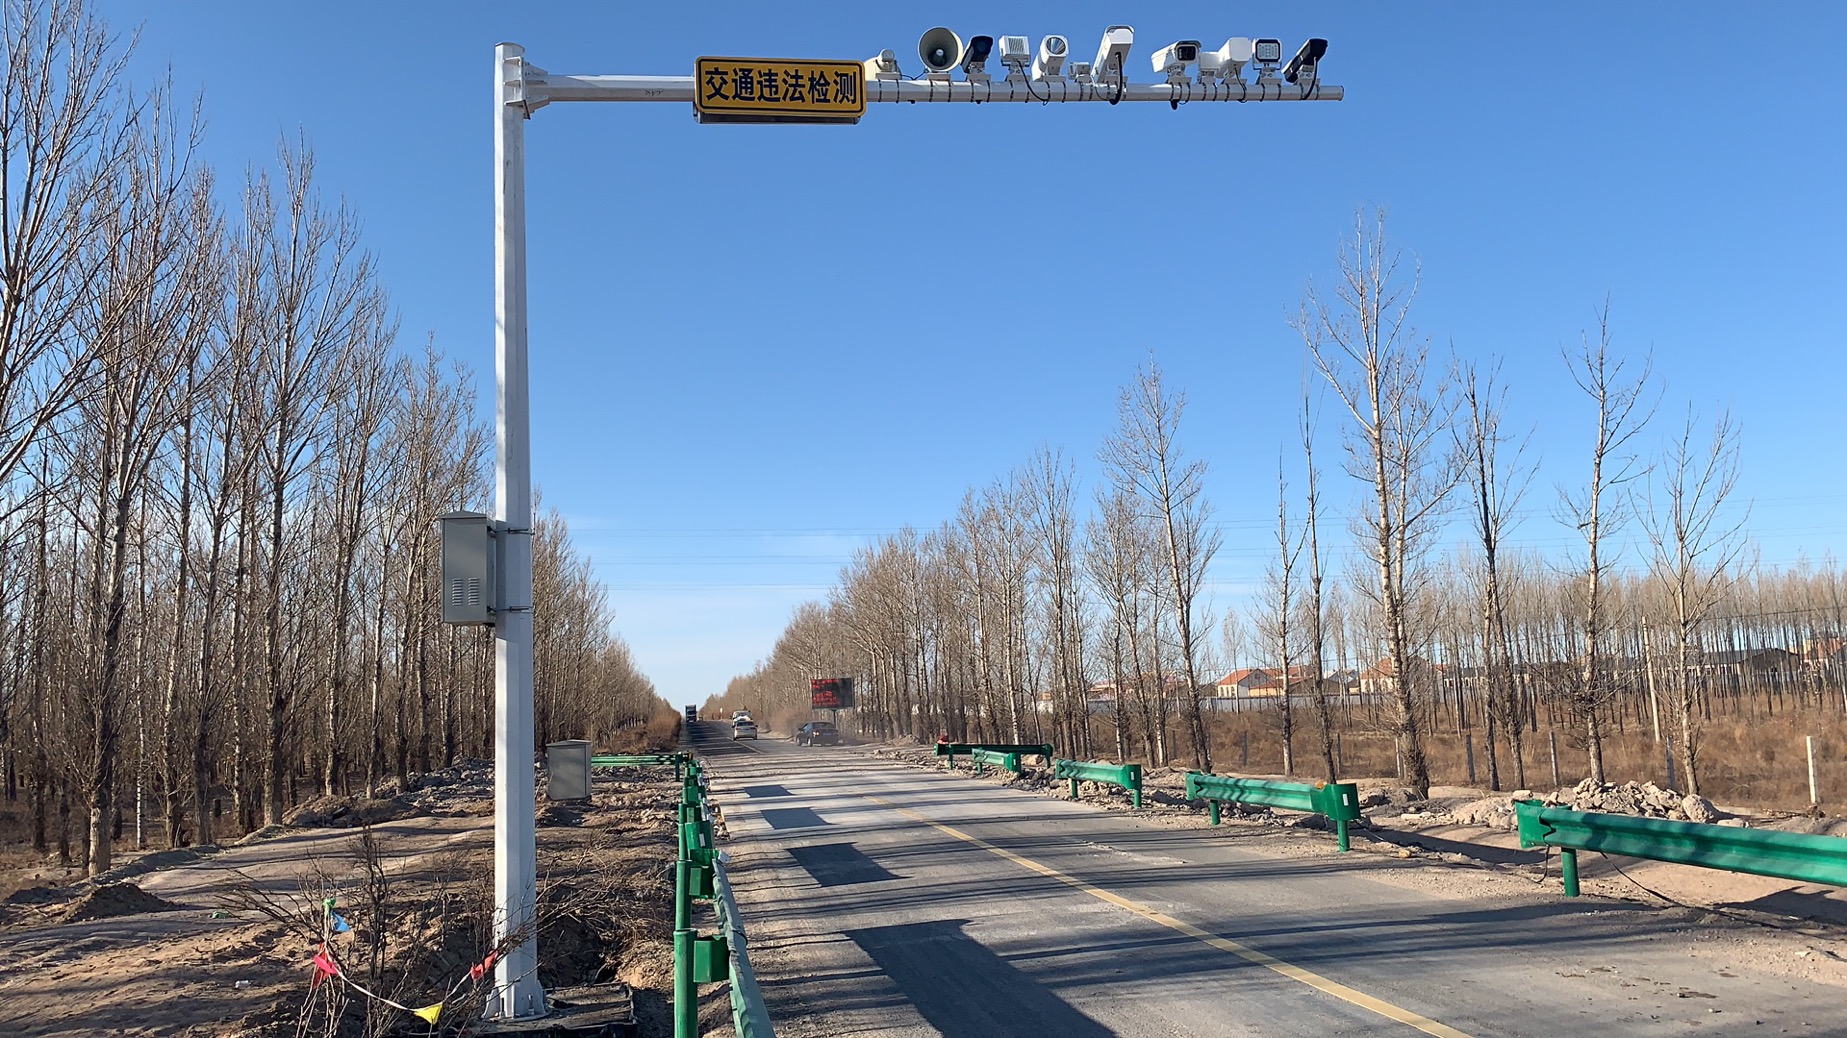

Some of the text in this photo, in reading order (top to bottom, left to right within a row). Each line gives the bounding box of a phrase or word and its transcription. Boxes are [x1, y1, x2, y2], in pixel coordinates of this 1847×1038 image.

[705, 67, 857, 104] 交通违法检测
